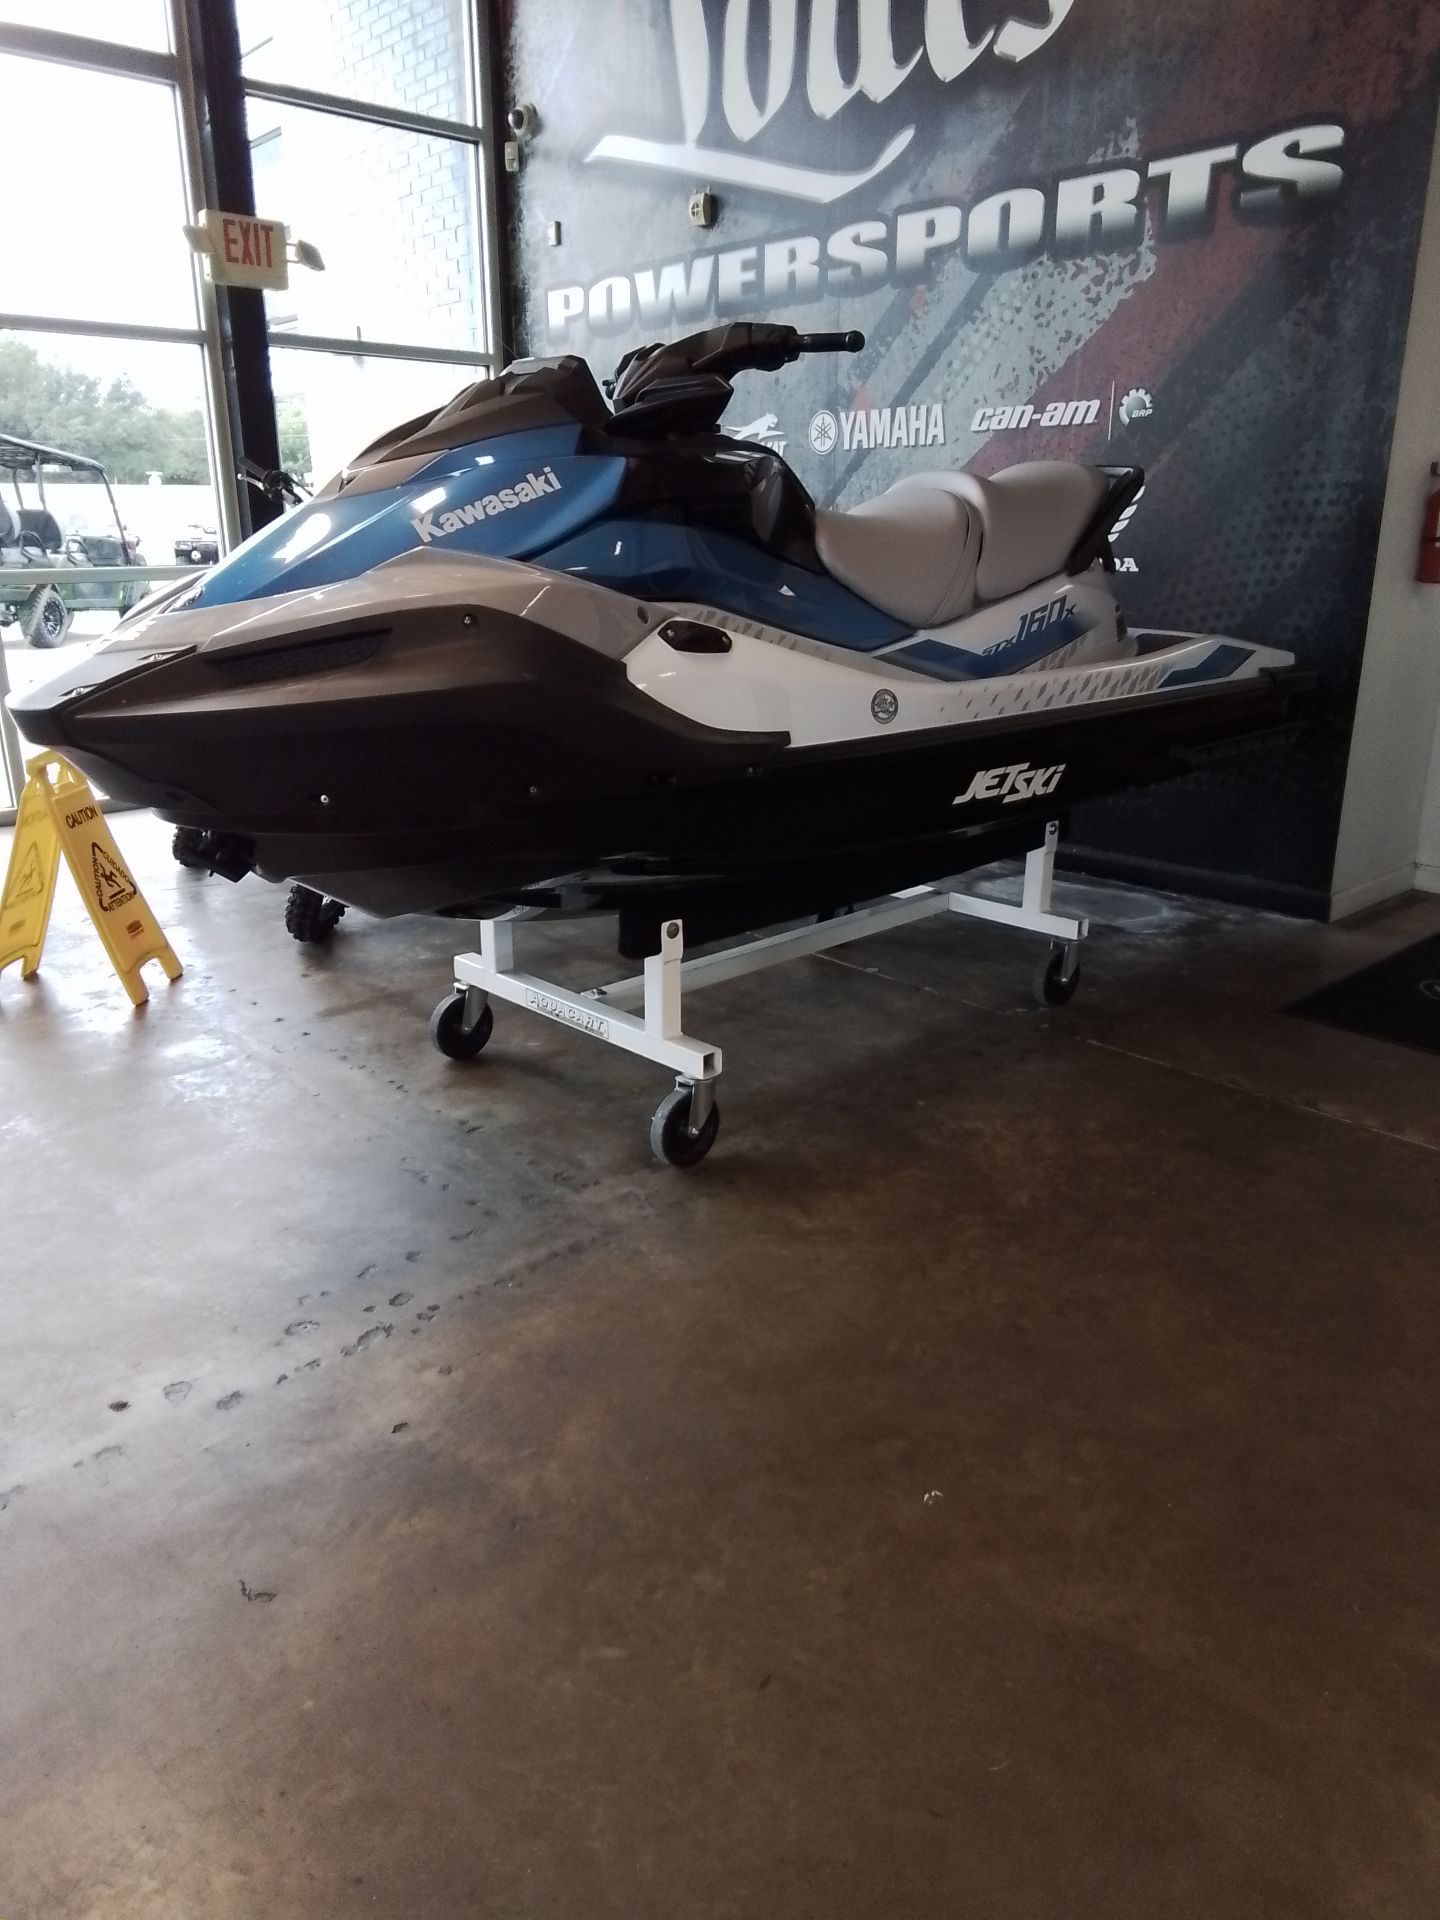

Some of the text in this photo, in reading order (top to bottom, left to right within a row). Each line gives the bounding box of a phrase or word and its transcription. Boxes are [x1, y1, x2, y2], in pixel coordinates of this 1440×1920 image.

[222, 218, 274, 268] EXIT
[546, 124, 1346, 338] POWERSPORTS
[840, 403, 945, 450] YAMAHA
[971, 399, 1101, 432] can-am
[1132, 409, 1153, 418] BRP
[410, 466, 562, 543] Kawasaki
[65, 804, 99, 829] CAUTION
[102, 851, 130, 882] CUIDADO
[107, 892, 135, 912] ATTENTION
[530, 994, 605, 1032] AQUACART
